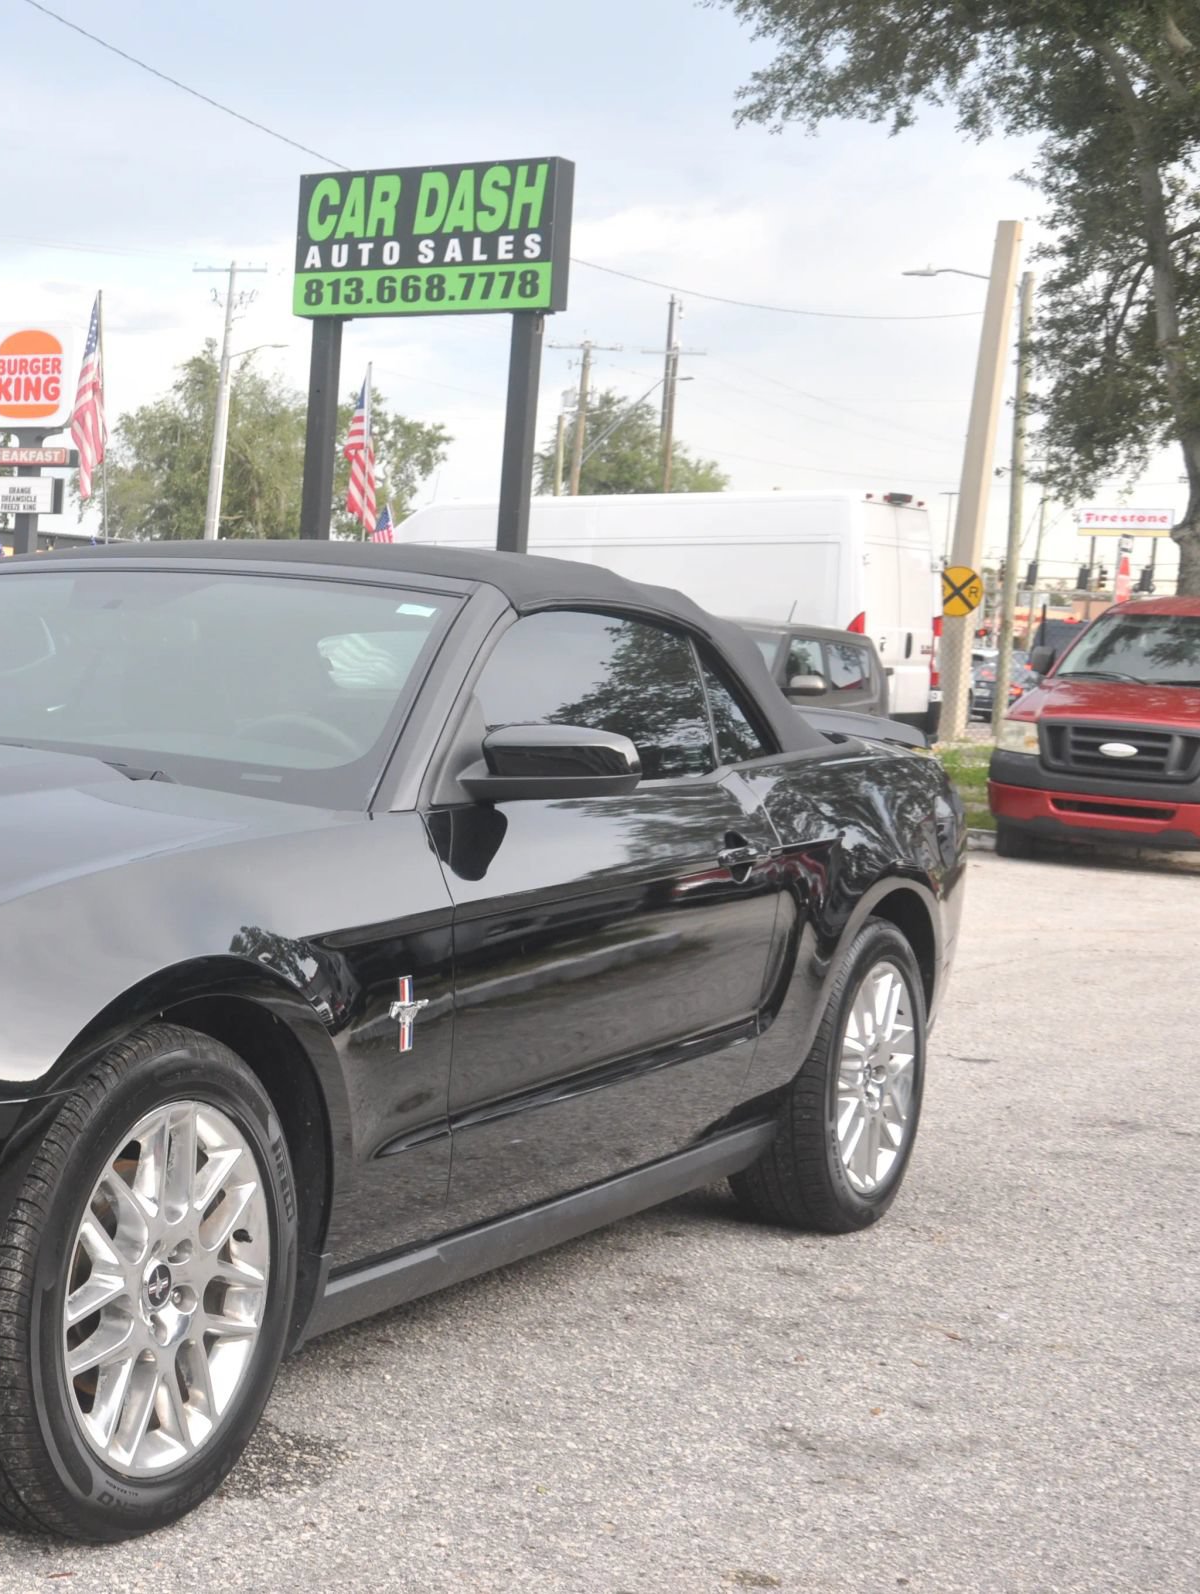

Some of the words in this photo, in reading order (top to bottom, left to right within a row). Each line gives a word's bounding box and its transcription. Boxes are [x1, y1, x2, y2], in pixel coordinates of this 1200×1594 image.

[306, 174, 402, 242] CAR
[412, 163, 549, 236] DASH
[303, 240, 401, 270] AUTO
[417, 233, 542, 264] SALES
[303, 269, 540, 307] 813.668.7778
[8, 487, 32, 495] ORANGE
[1, 495, 37, 503] DREAMSICLE
[0, 503, 20, 511] FREEZE
[1084, 512, 1168, 524] Firestone
[968, 586, 979, 598] R
